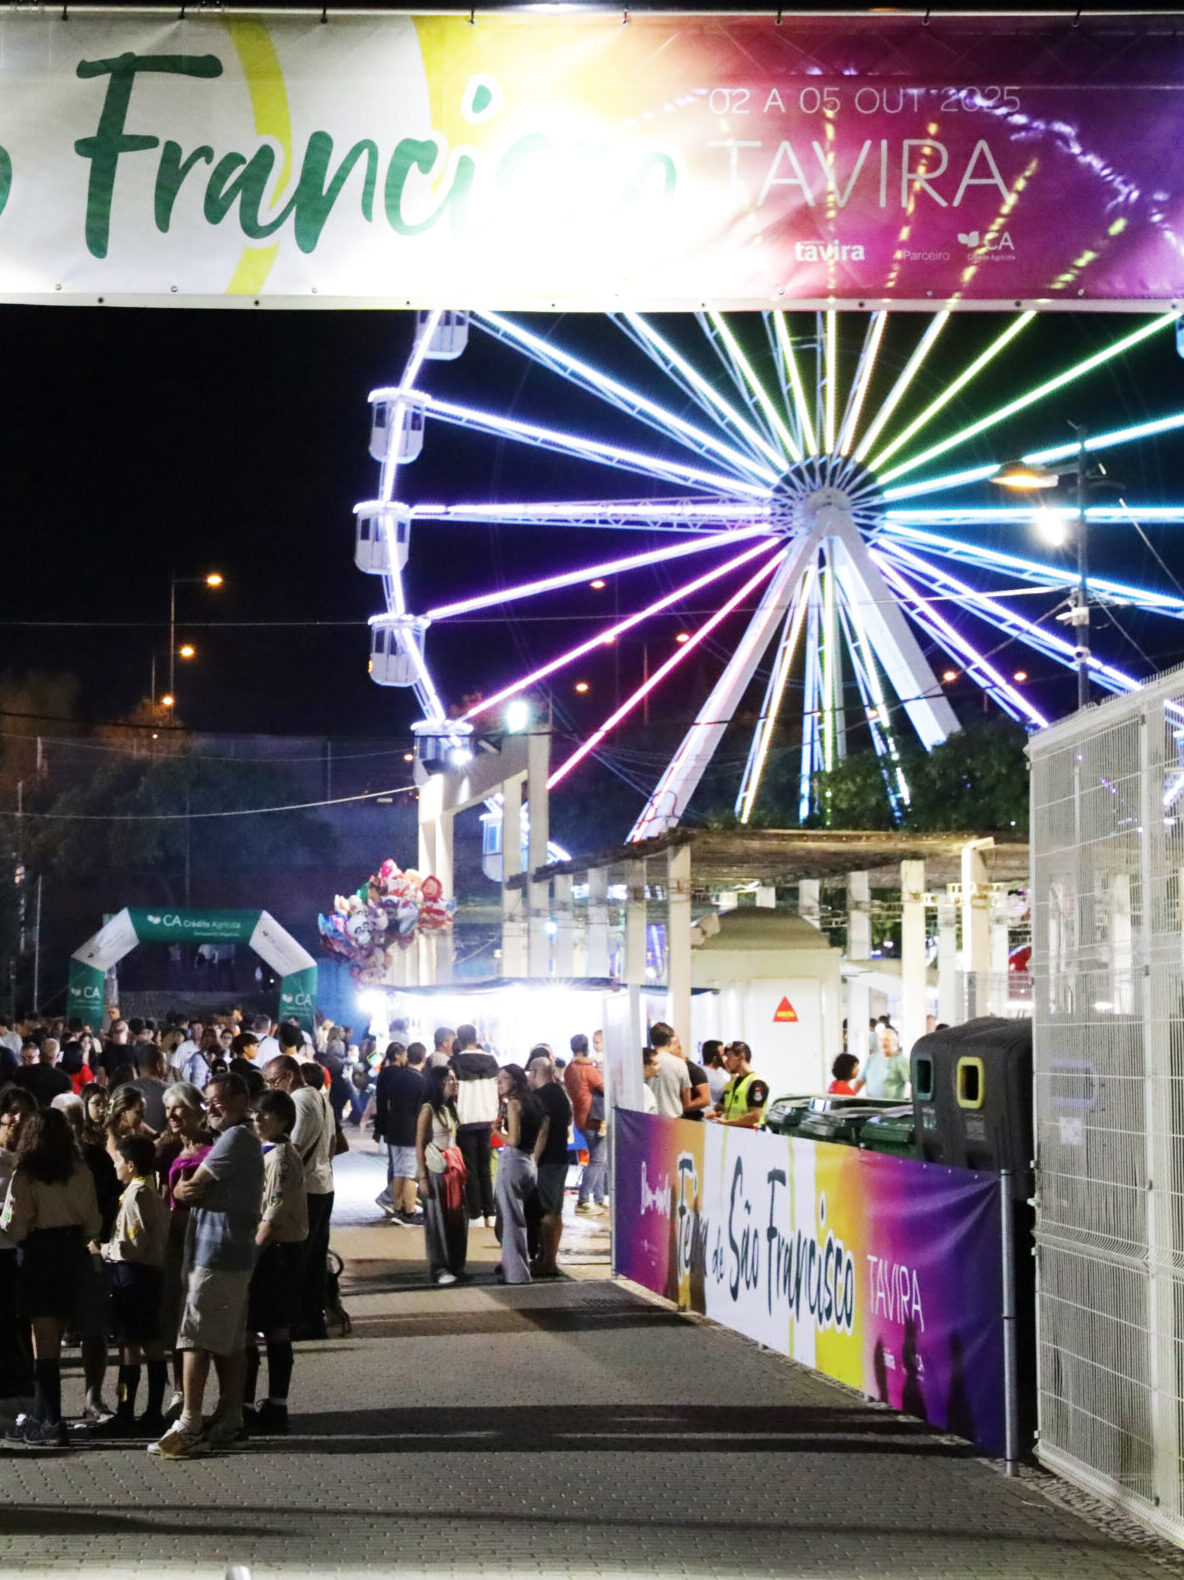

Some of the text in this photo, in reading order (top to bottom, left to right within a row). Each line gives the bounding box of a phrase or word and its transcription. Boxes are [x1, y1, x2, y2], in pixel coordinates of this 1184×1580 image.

[708, 86, 1021, 114] 02 A 05 OUT 2025
[706, 138, 1013, 208] TAVIRA
[794, 239, 866, 261] tavira
[984, 231, 1016, 251] CA
[902, 249, 951, 261] Parceiro
[162, 914, 182, 927] CA
[83, 985, 101, 998] CA
[295, 993, 312, 1006] CA
[728, 1154, 760, 1302] São
[766, 1165, 854, 1329] Francisco
[866, 1254, 925, 1333] TAVIRA
